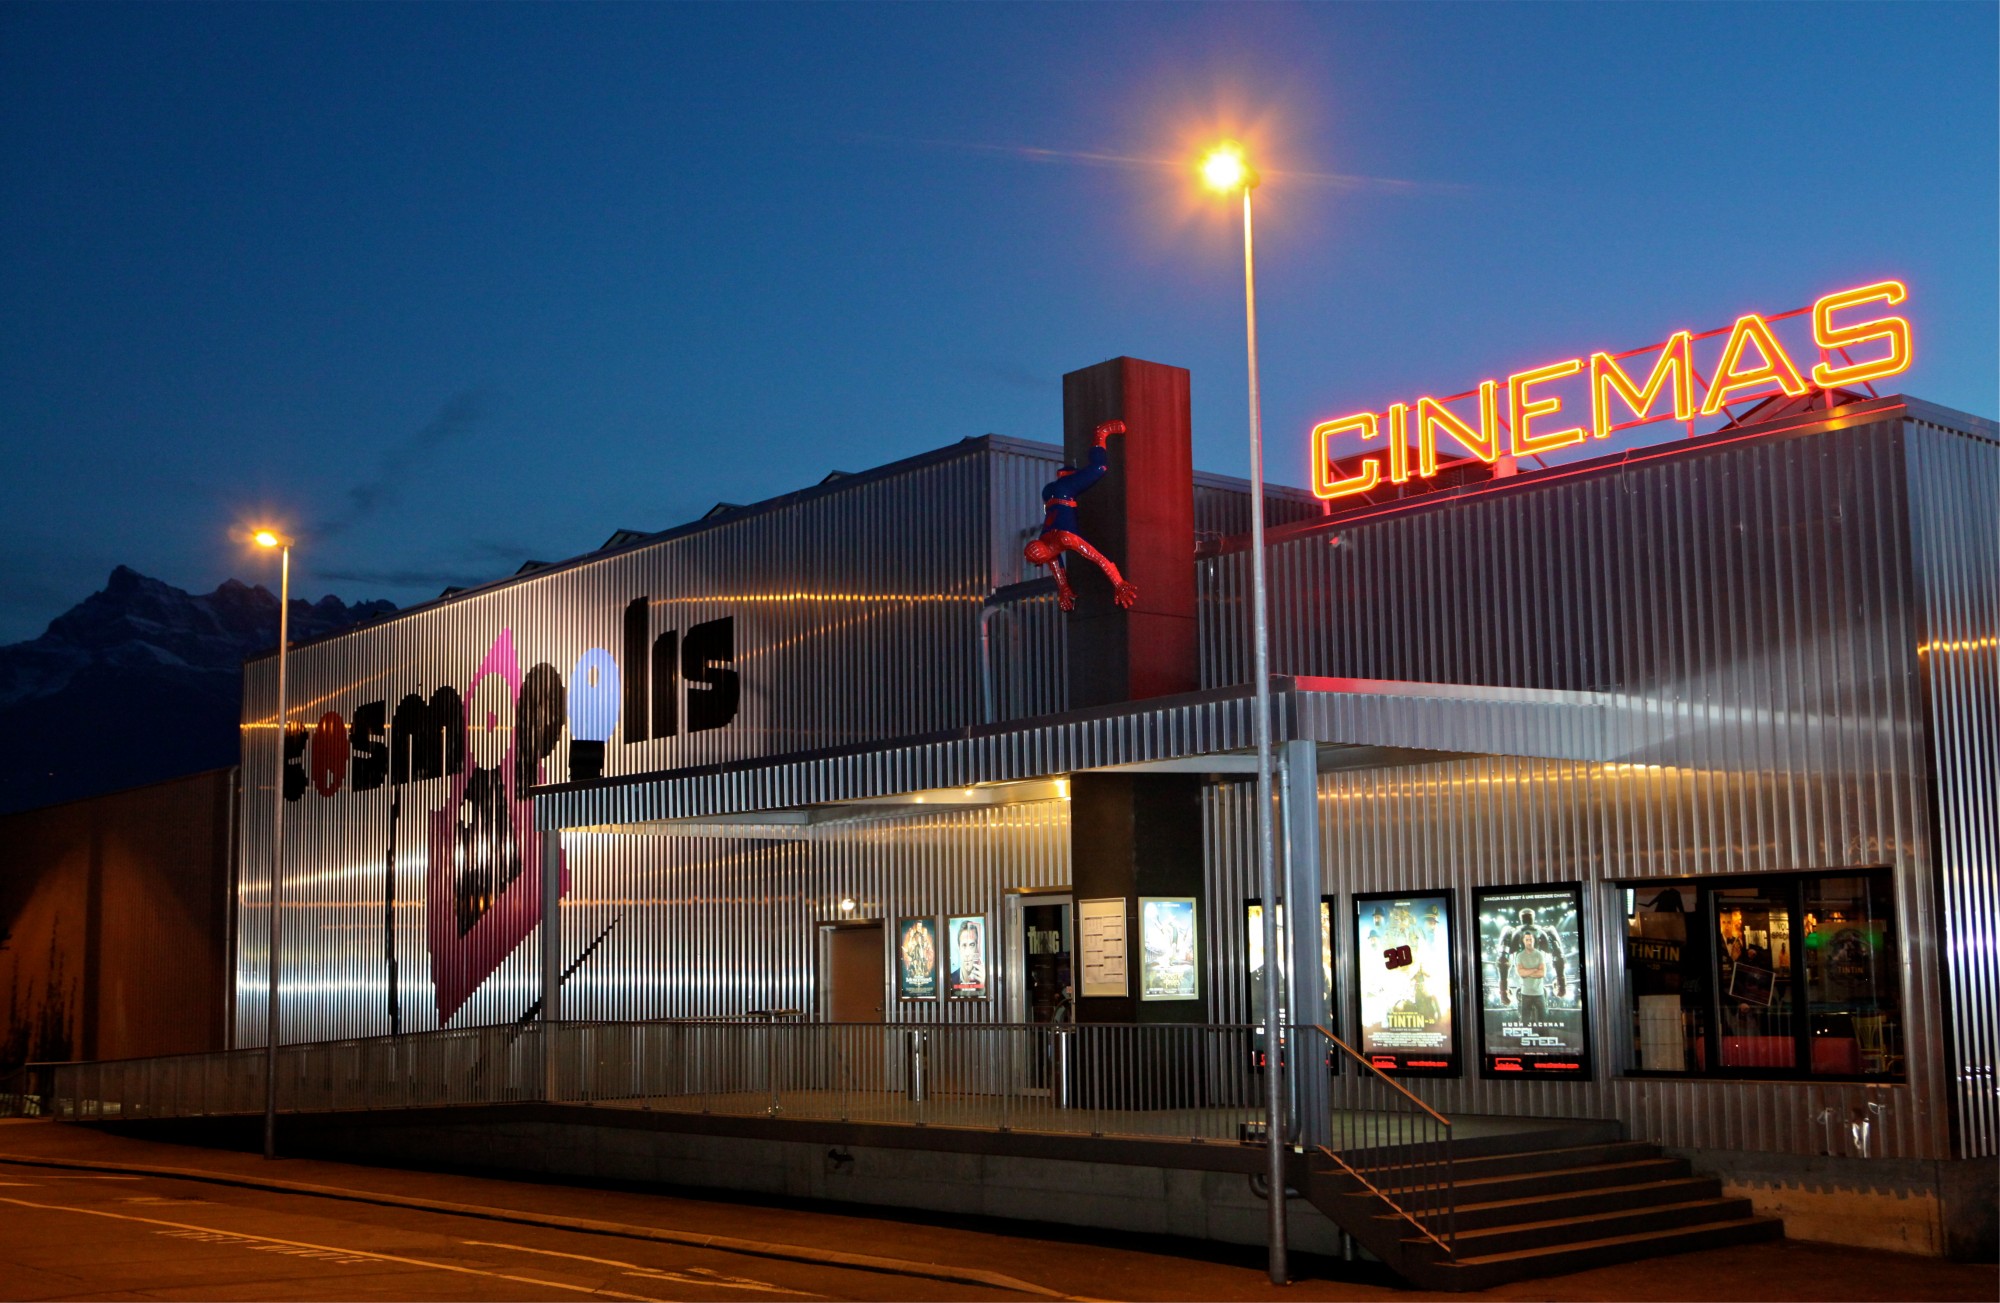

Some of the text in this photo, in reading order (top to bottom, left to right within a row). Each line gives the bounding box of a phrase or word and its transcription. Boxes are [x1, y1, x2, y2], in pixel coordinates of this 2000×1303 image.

[1311, 280, 1912, 501] CINEMAS
[1630, 942, 1680, 961] TINTIN
[1837, 966, 1864, 974] TINTIN
[1388, 1015, 1425, 1028] TINTIN
[1502, 1028, 1540, 1037] REAL
[1521, 1037, 1567, 1047] STEEL
